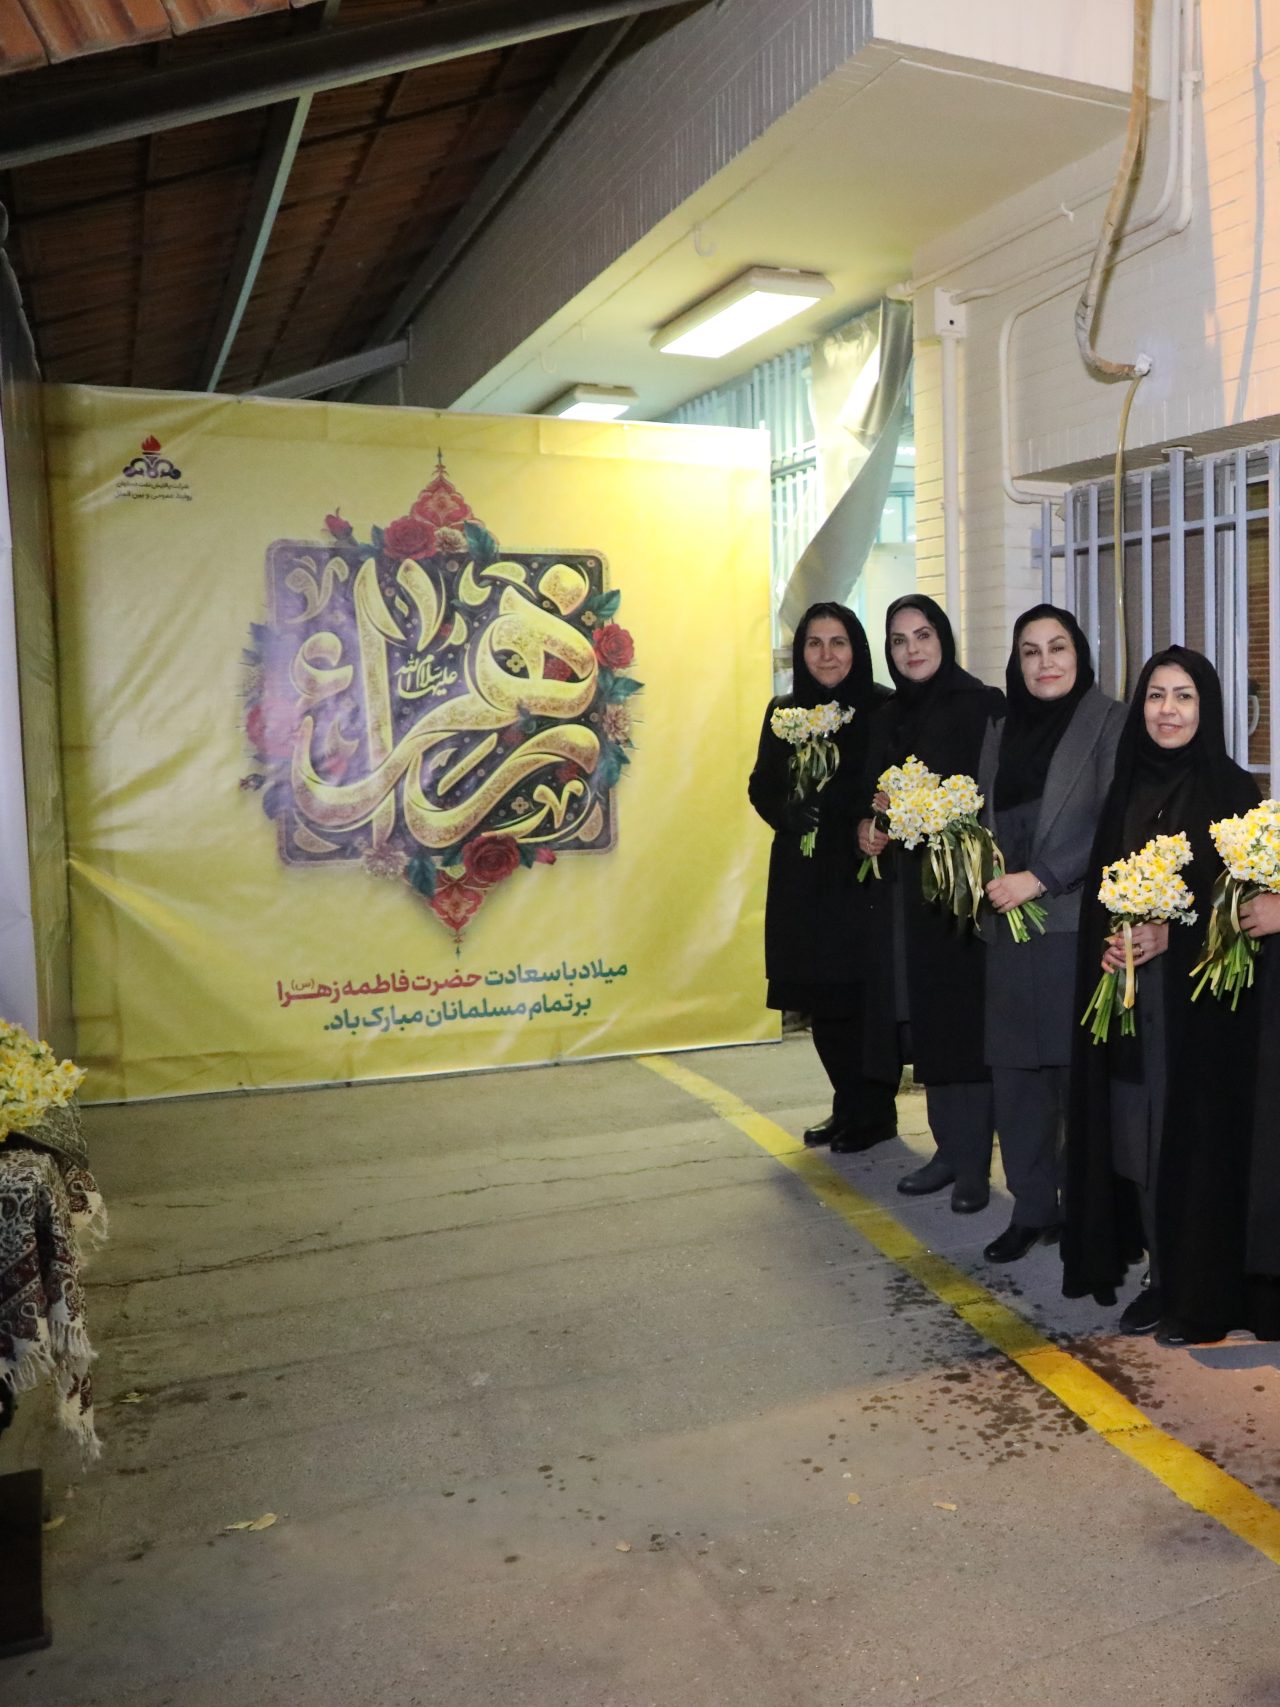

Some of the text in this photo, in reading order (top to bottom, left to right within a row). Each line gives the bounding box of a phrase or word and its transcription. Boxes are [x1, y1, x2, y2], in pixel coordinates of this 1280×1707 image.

[342, 969, 410, 996] فاطمه
[411, 968, 482, 997] حضرت
[578, 958, 628, 984] میلاد
[362, 1004, 424, 1033] مبارک
[425, 997, 527, 1028] مسلمانان
[528, 993, 574, 1021] تمام
[572, 996, 592, 1017] بر
